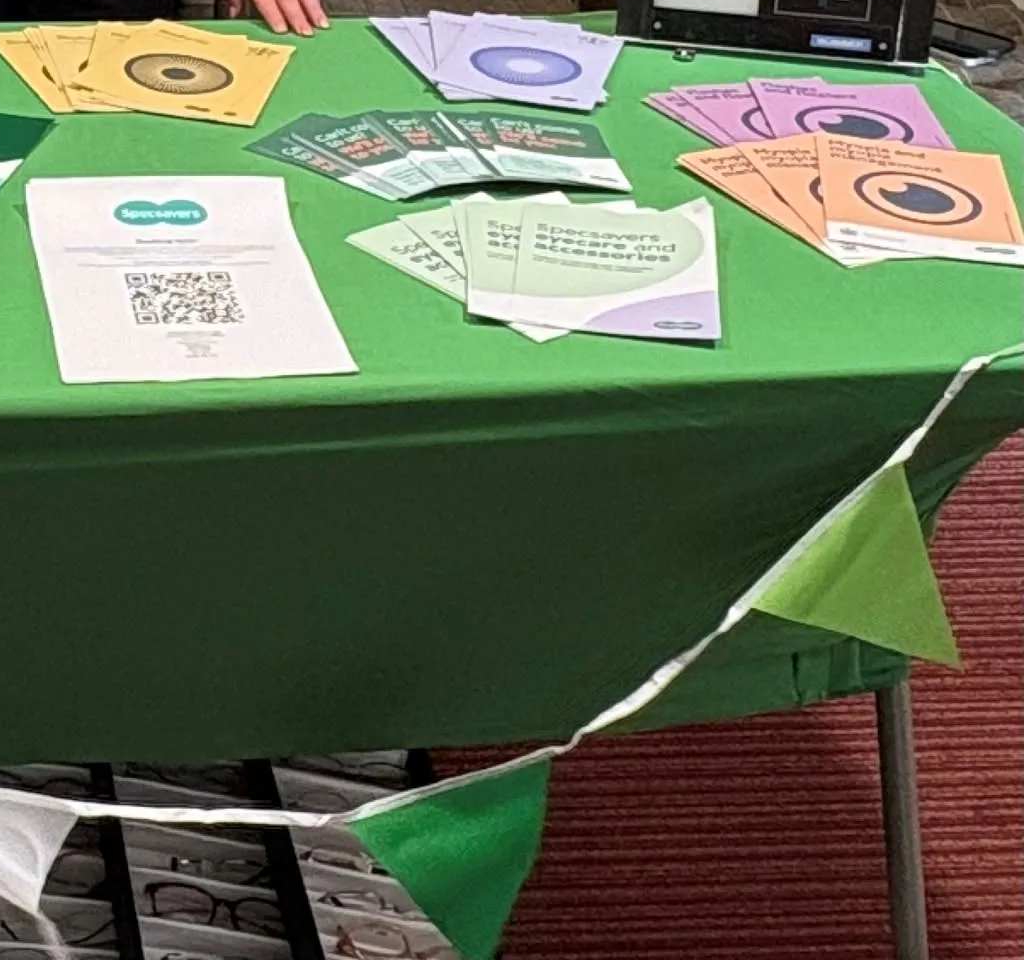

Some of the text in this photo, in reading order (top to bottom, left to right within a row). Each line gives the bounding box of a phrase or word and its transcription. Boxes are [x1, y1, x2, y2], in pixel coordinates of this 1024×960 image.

[537, 223, 660, 242] Specsavers
[534, 242, 671, 262] accessories
[535, 233, 676, 253] eyecare and
